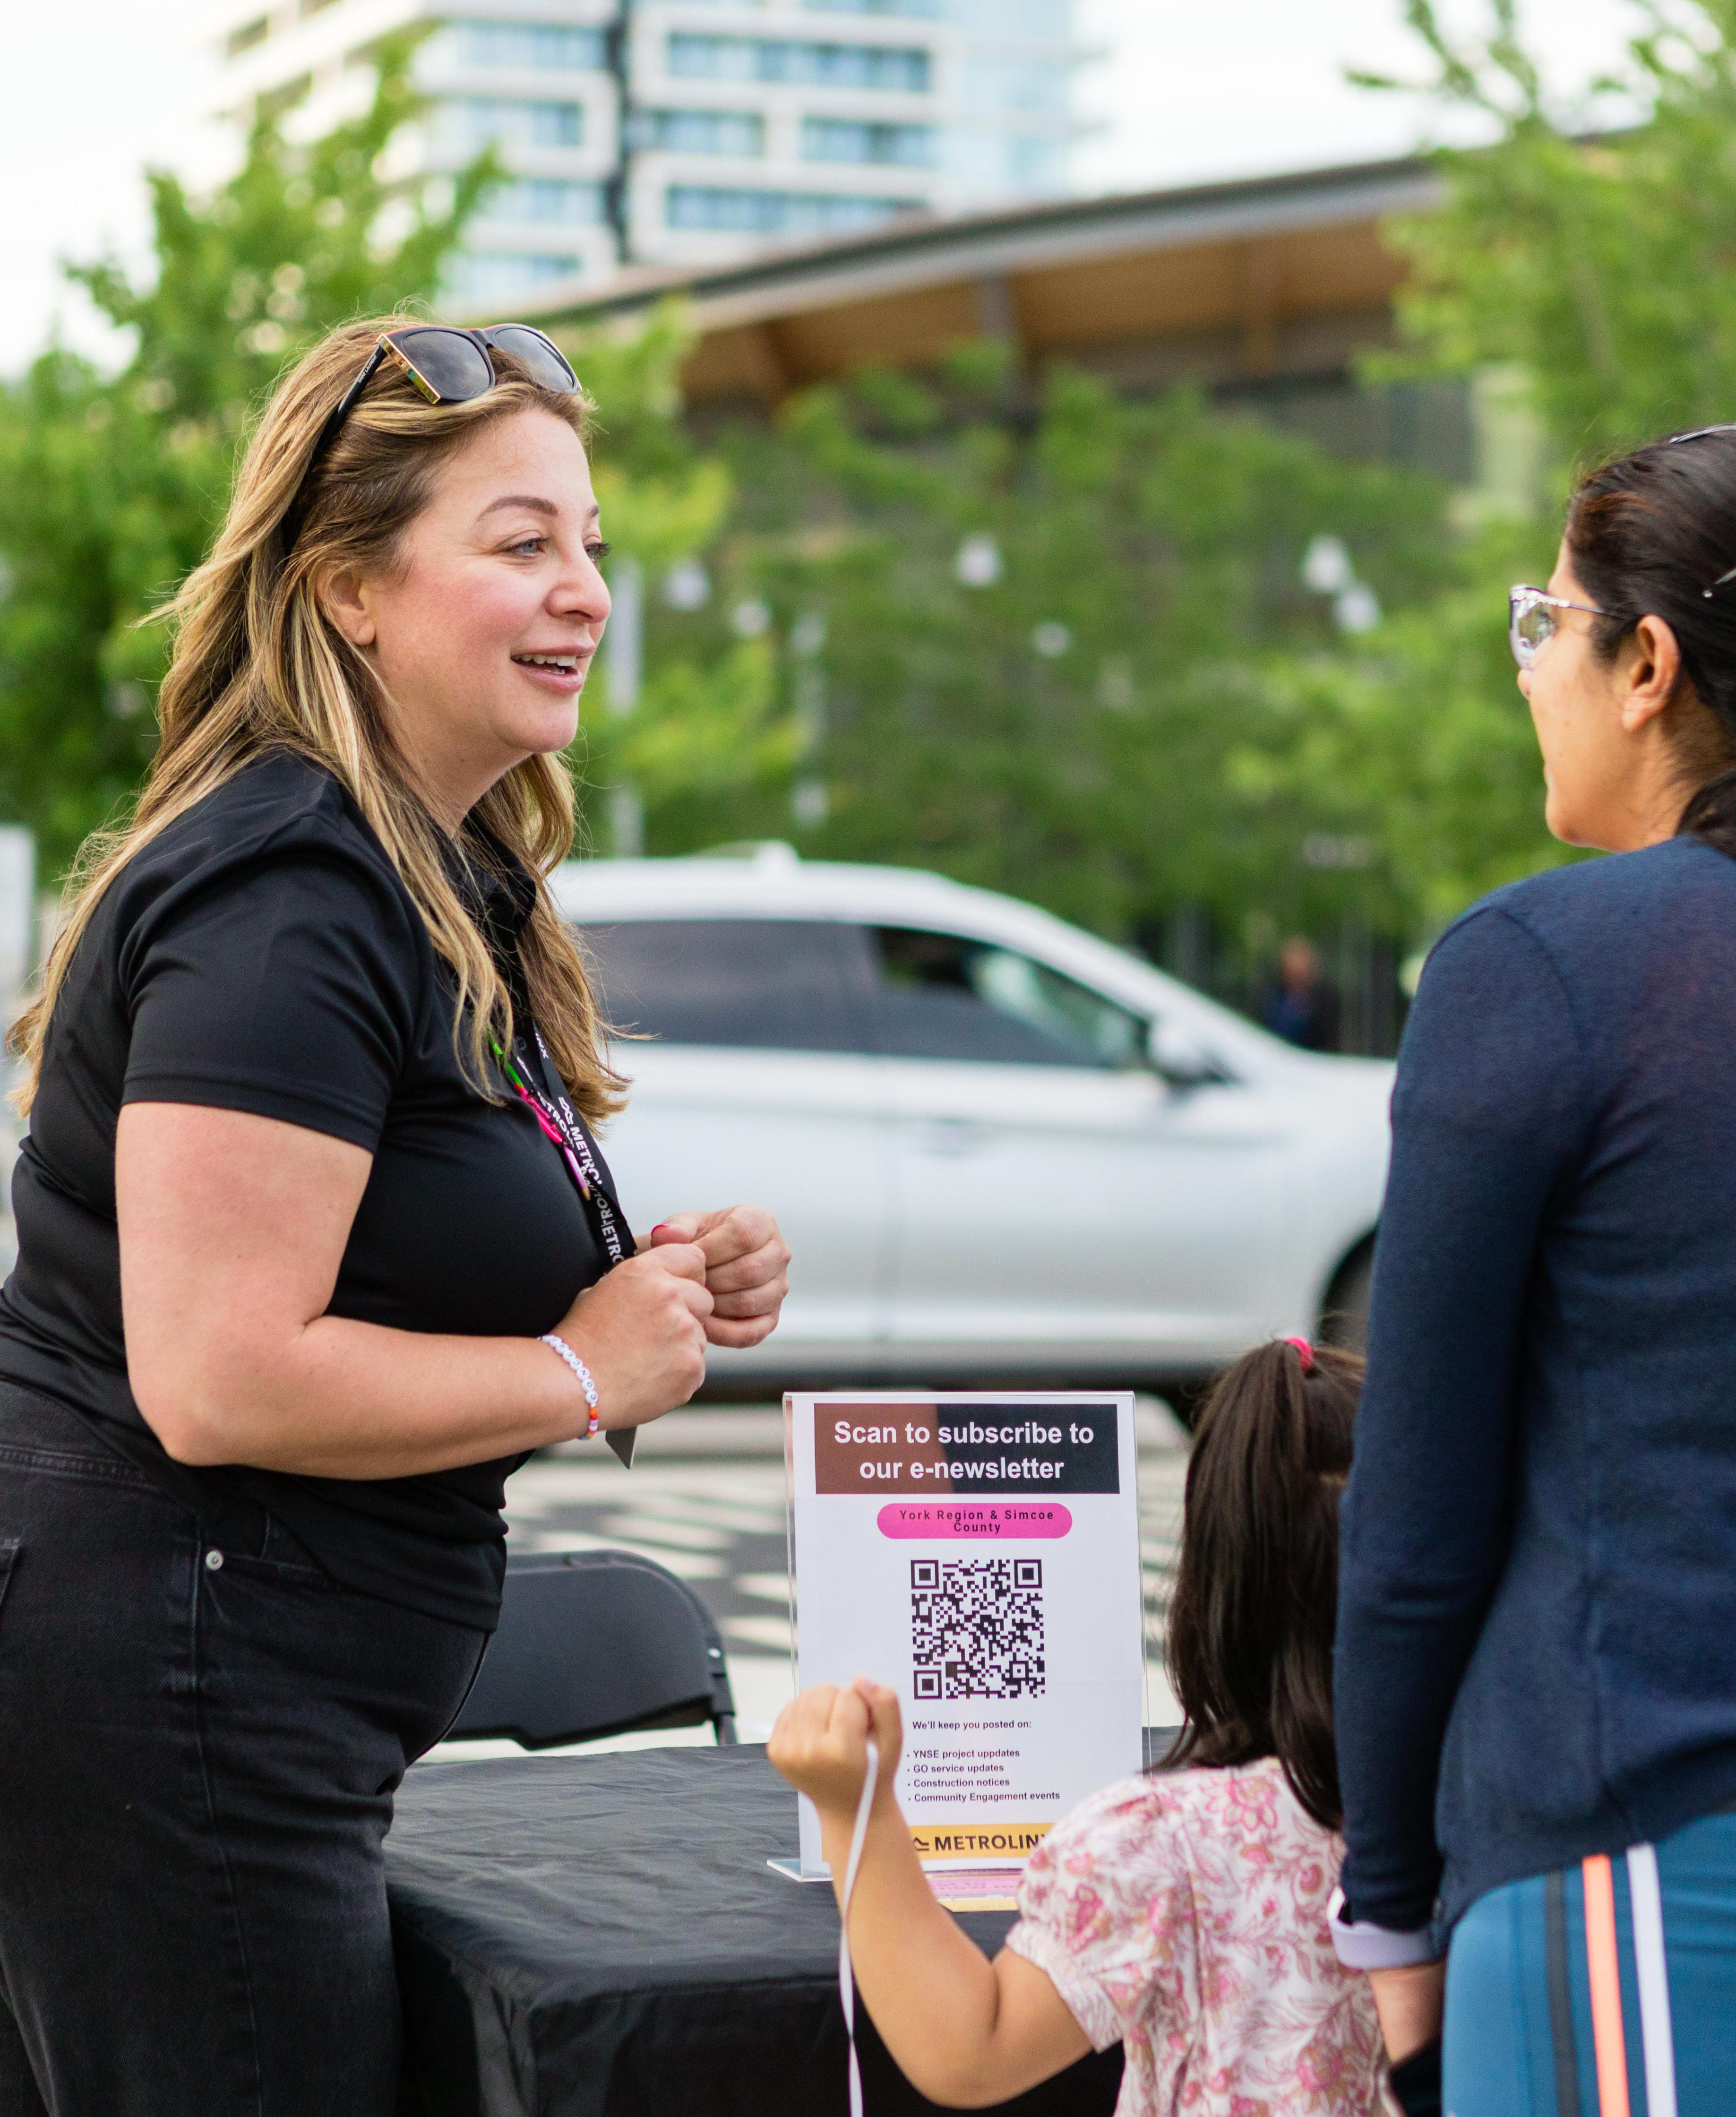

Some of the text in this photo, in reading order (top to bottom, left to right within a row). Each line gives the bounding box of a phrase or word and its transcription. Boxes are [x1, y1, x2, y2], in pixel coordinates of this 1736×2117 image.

[834, 1421, 1094, 1444] Scan to subscribe to
[859, 1457, 1065, 1479] our e-newsletter
[900, 1510, 1054, 1522] York Region & Simcoe
[954, 1523, 1001, 1534] County
[912, 1721, 936, 1730] We'll
[938, 1721, 960, 1730] keep
[963, 1722, 980, 1730] you
[983, 1721, 1014, 1730] posted
[913, 1749, 1020, 1760] YNSE project uppdates
[913, 1764, 1004, 1773] GO service updates
[914, 1778, 1010, 1788] Construction notices
[914, 1792, 1060, 1803] Community Engagement events
[935, 1834, 1045, 1851] METROLIN
